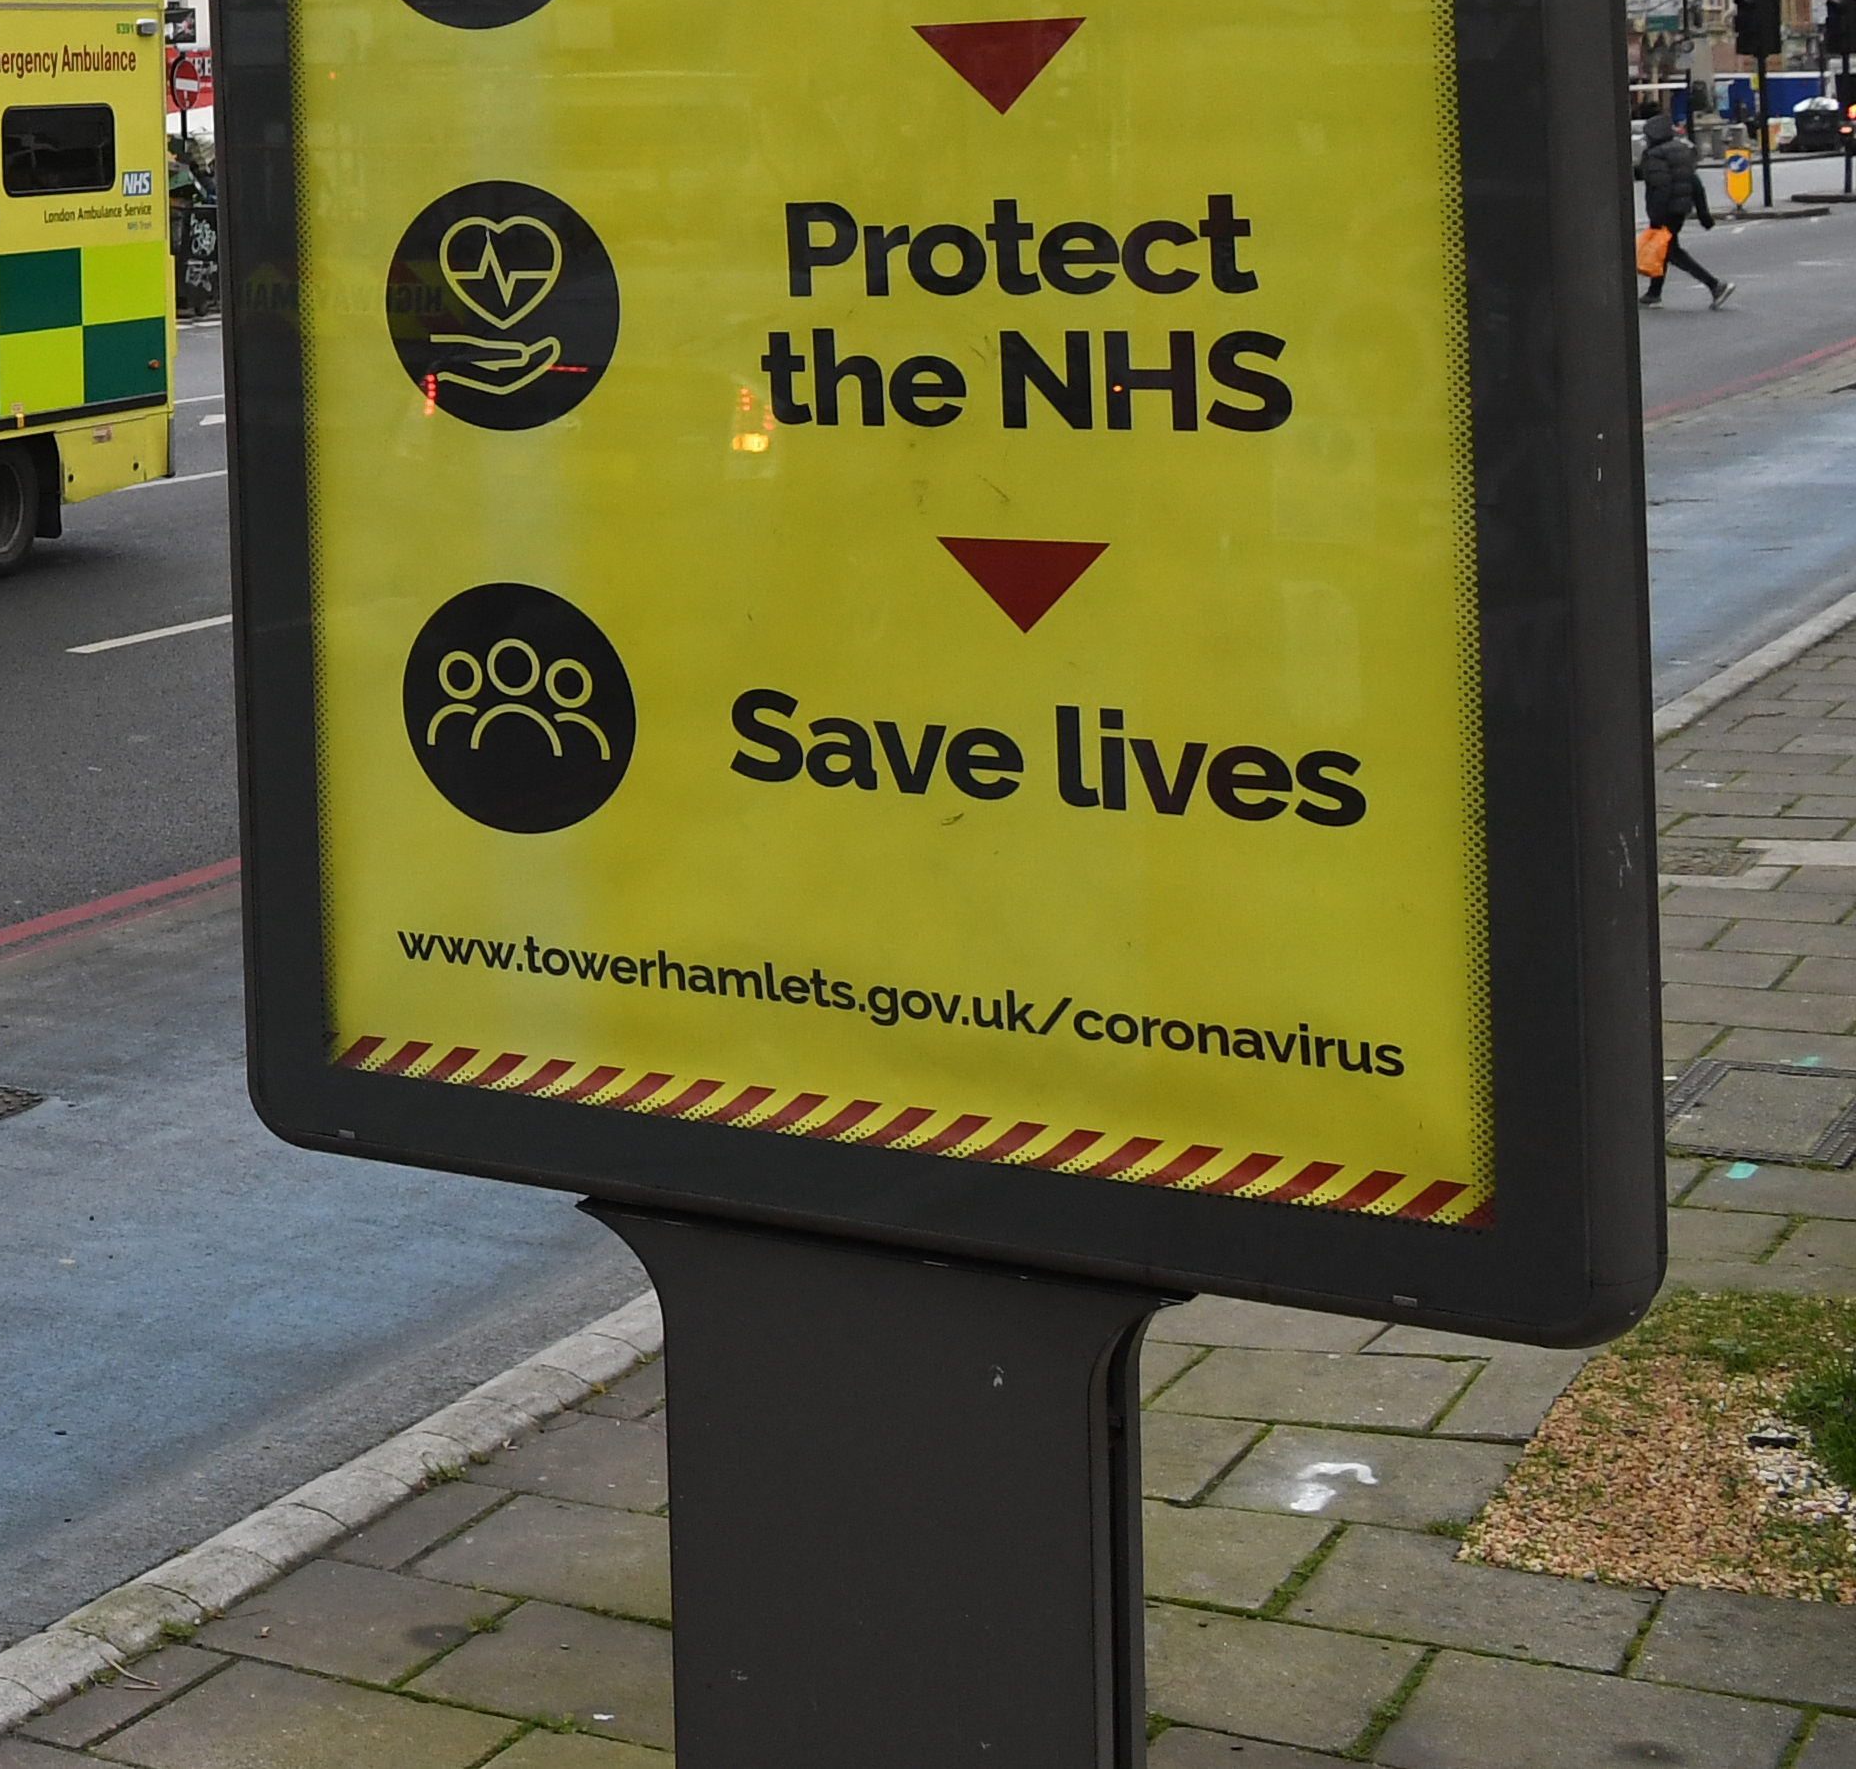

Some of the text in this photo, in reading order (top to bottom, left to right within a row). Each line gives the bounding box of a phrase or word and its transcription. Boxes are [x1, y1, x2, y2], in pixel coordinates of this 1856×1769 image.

[62, 44, 136, 73] Ambulance
[44, 202, 152, 224] London Ambulance Service
[122, 171, 152, 196] NHS
[785, 193, 1259, 297] Protect
[760, 328, 1293, 432] the NHS
[729, 687, 1368, 828] Save lives
[396, 929, 1405, 1079] www.towerhamlets.gov.uk/coronavirus
